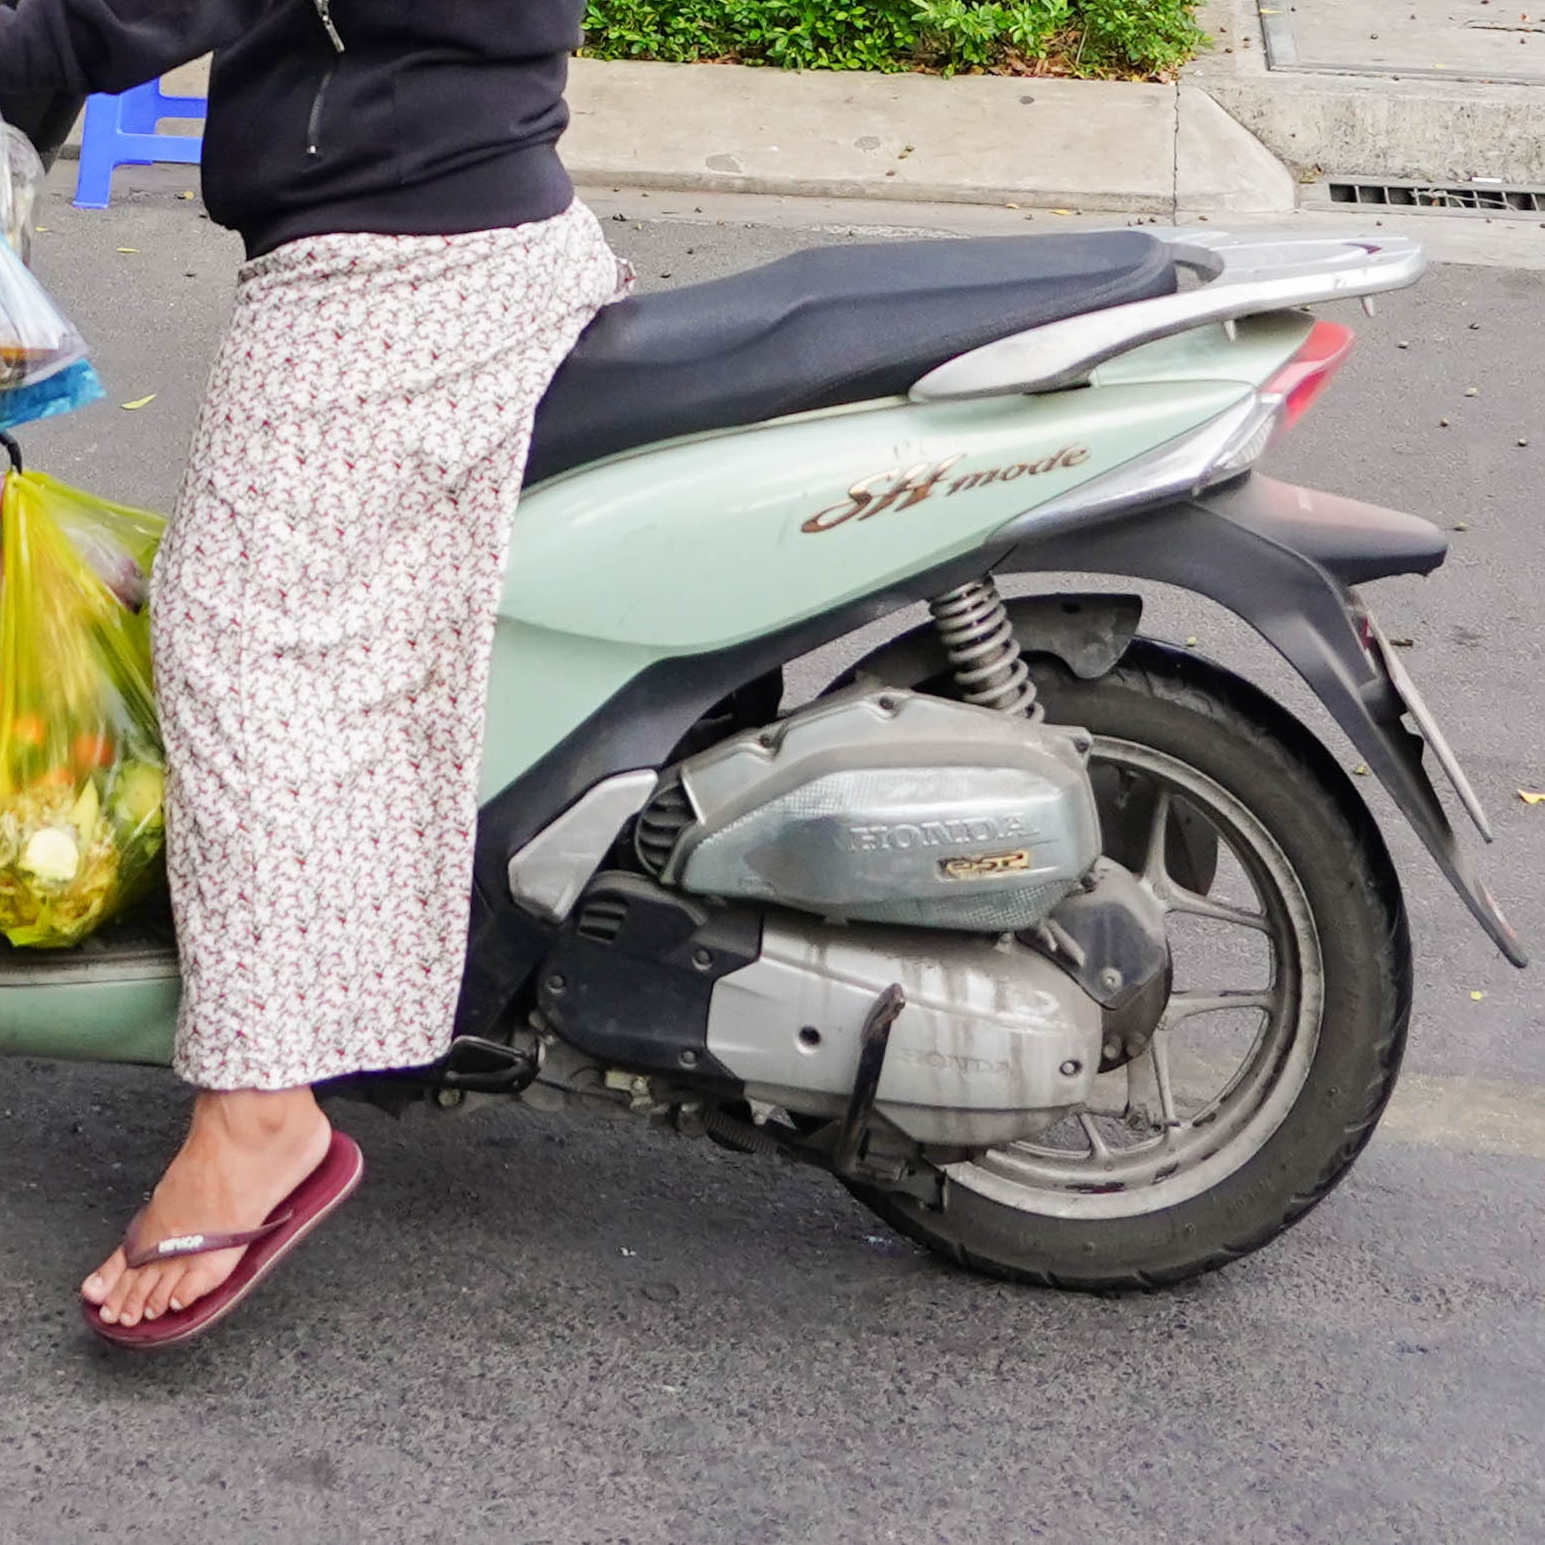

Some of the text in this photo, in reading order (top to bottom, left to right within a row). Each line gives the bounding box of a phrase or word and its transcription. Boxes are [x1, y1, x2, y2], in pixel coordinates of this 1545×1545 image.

[801, 441, 1092, 533] SH mode
[849, 811, 1040, 851] HONDA
